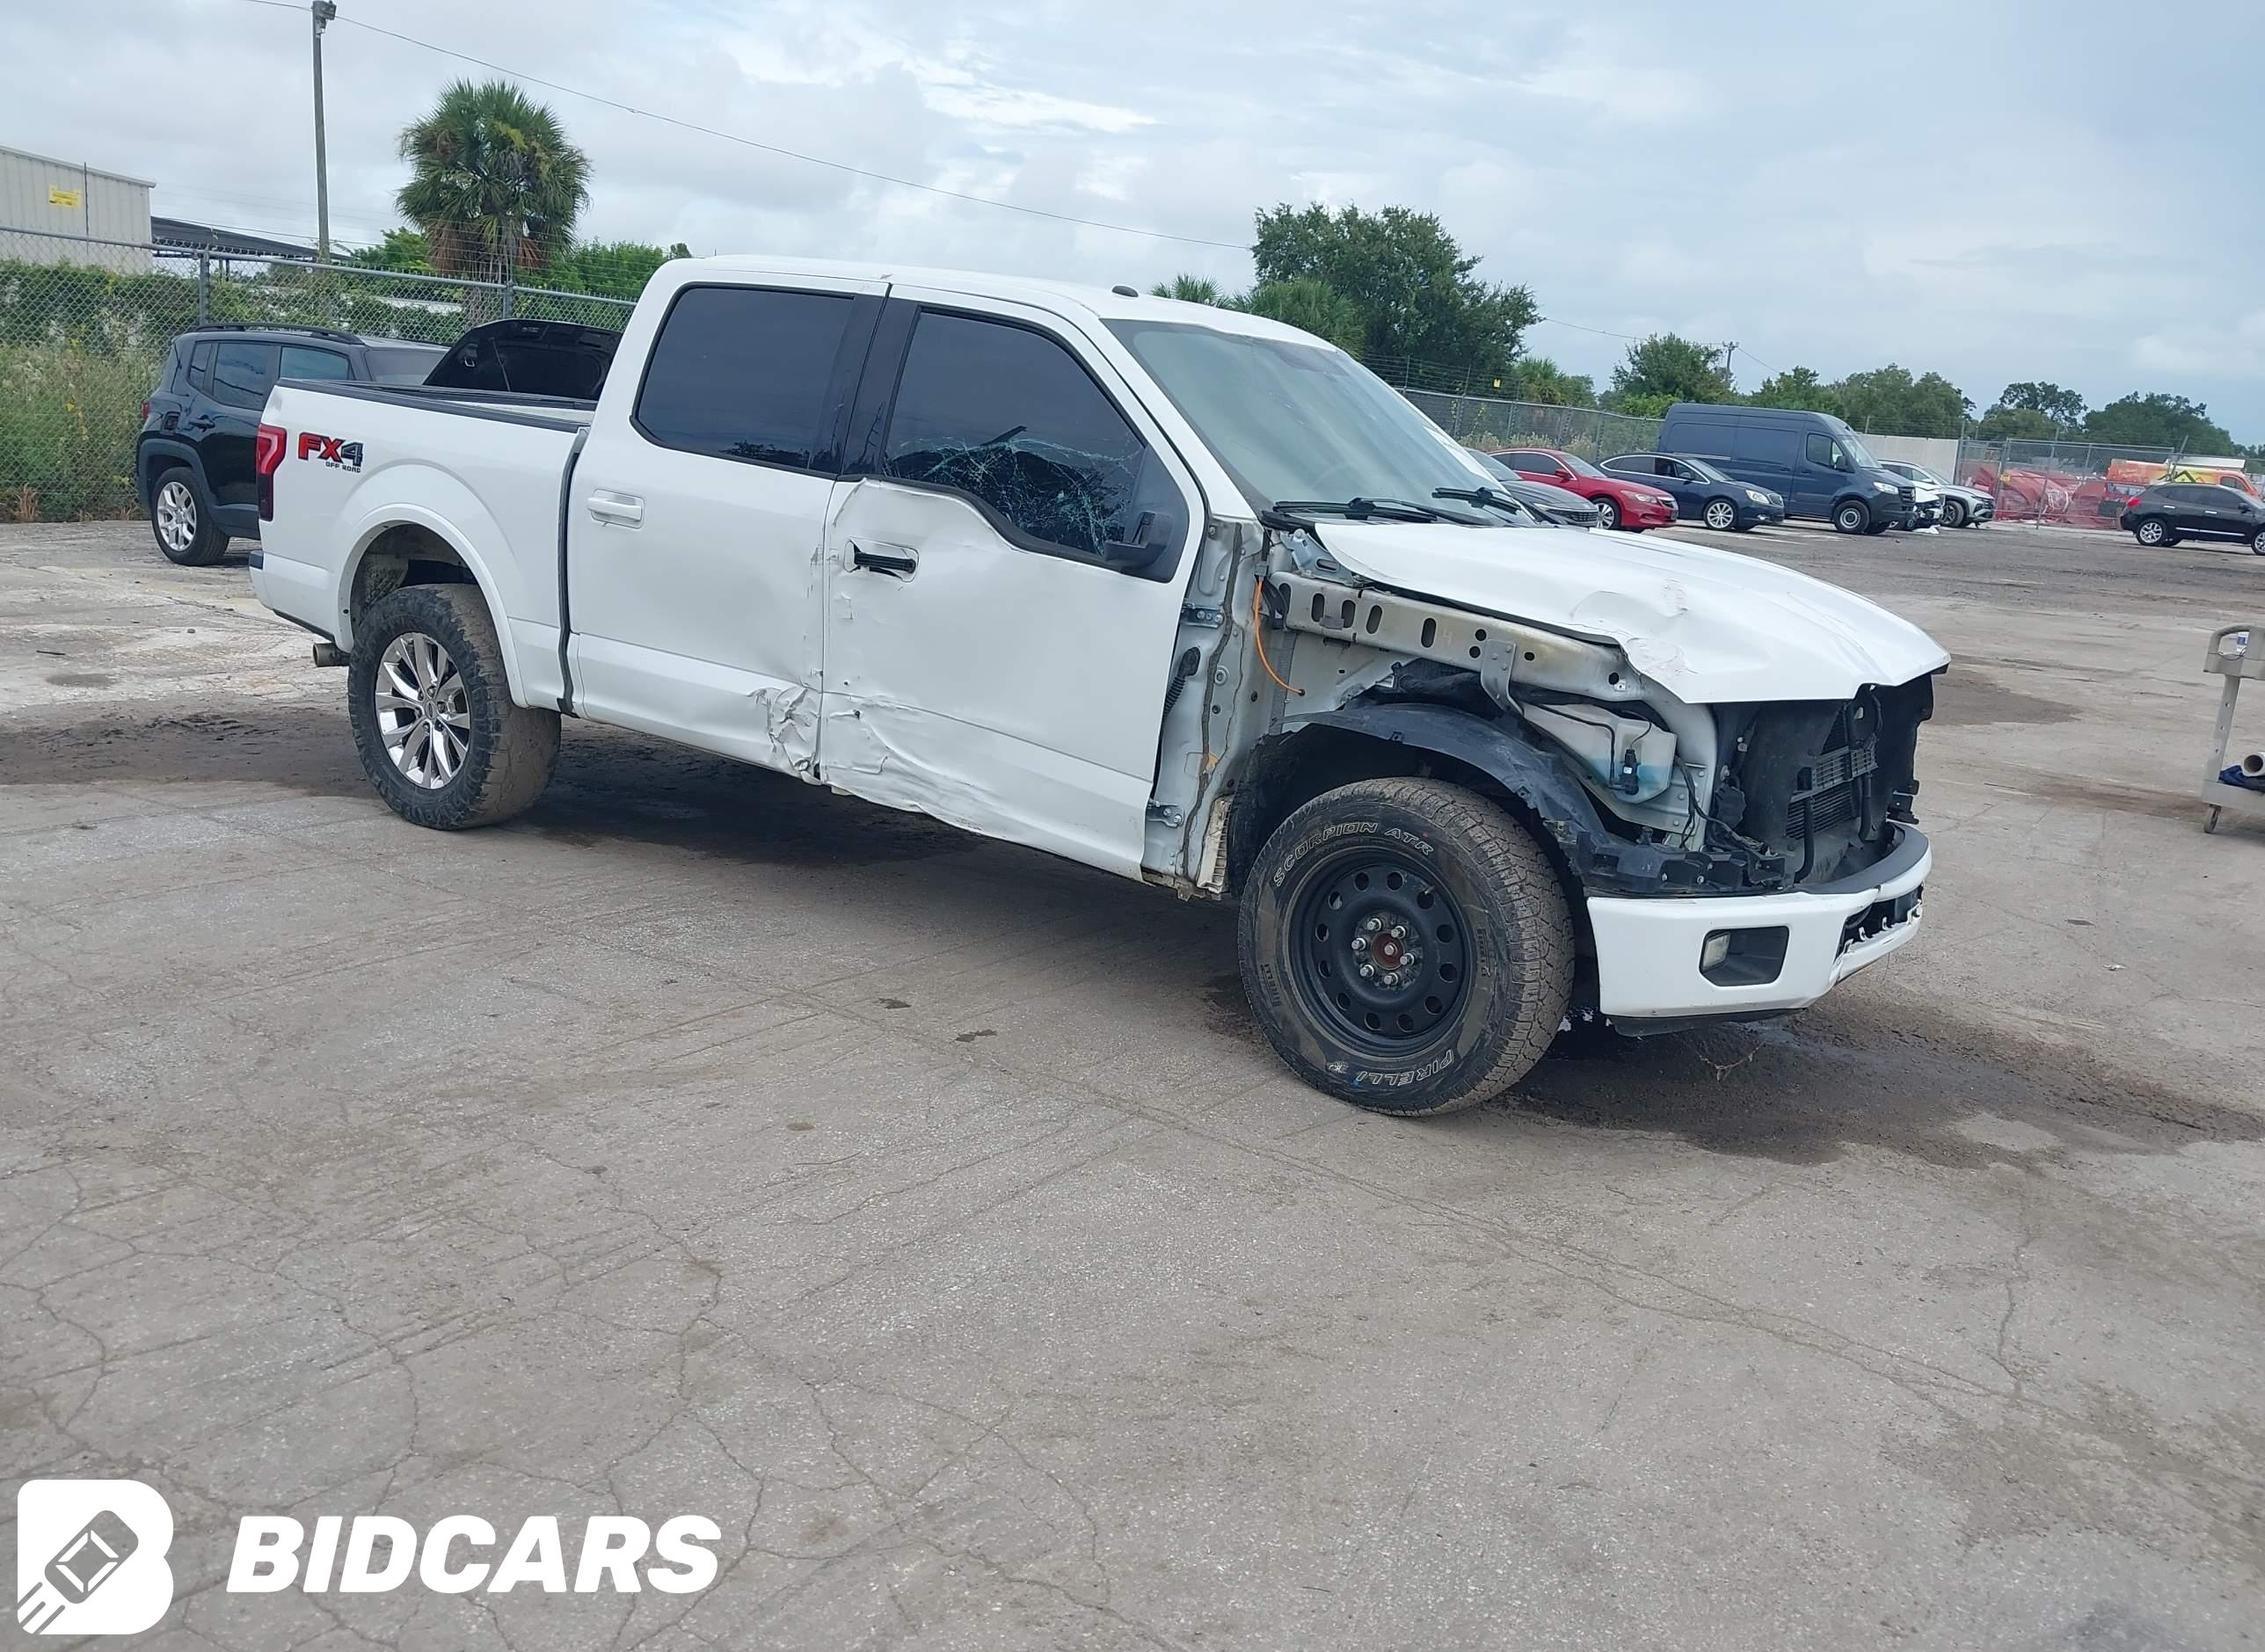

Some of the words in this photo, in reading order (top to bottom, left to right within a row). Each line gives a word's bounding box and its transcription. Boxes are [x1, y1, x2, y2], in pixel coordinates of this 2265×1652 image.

[298, 432, 364, 467] FX4
[342, 464, 361, 473] ROAD
[1273, 822, 1379, 887] SCORPION
[1384, 827, 1434, 856] ATR
[1356, 1049, 1454, 1087] PIRELLI
